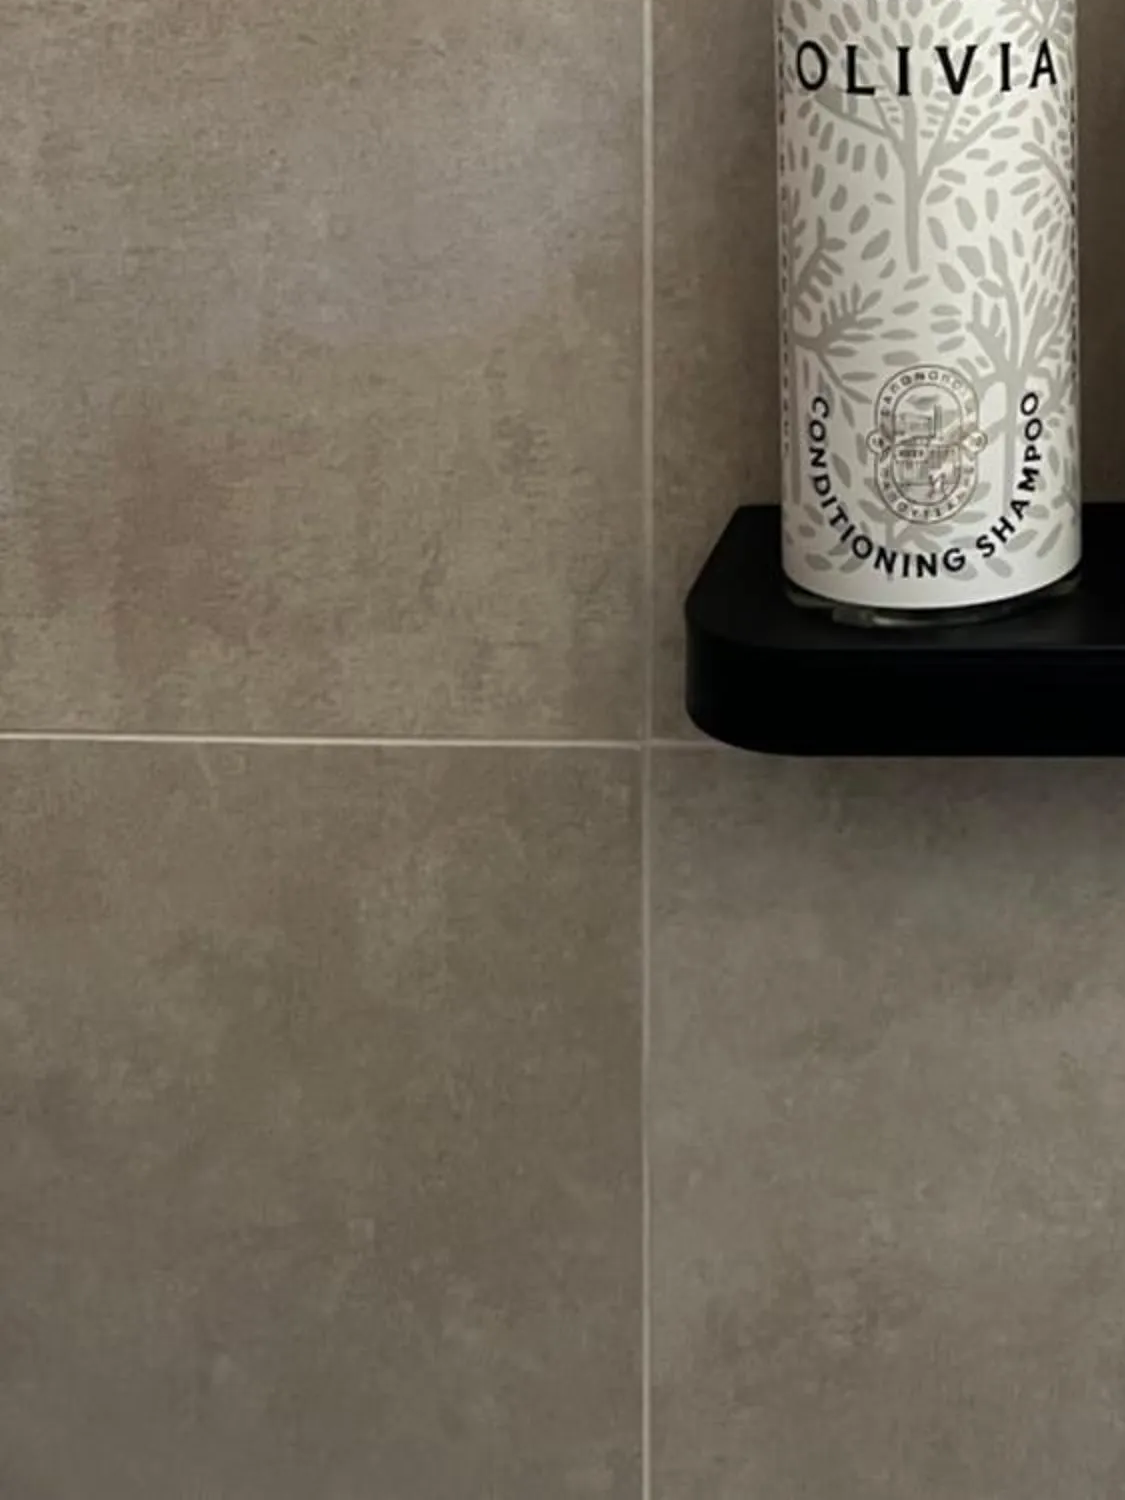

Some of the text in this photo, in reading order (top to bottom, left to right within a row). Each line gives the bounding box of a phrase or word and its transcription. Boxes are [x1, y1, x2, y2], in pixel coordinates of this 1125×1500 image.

[796, 38, 1057, 96] OLIVIA
[809, 397, 966, 578] CONDITIONING
[976, 392, 1043, 558] SHAMPOO
